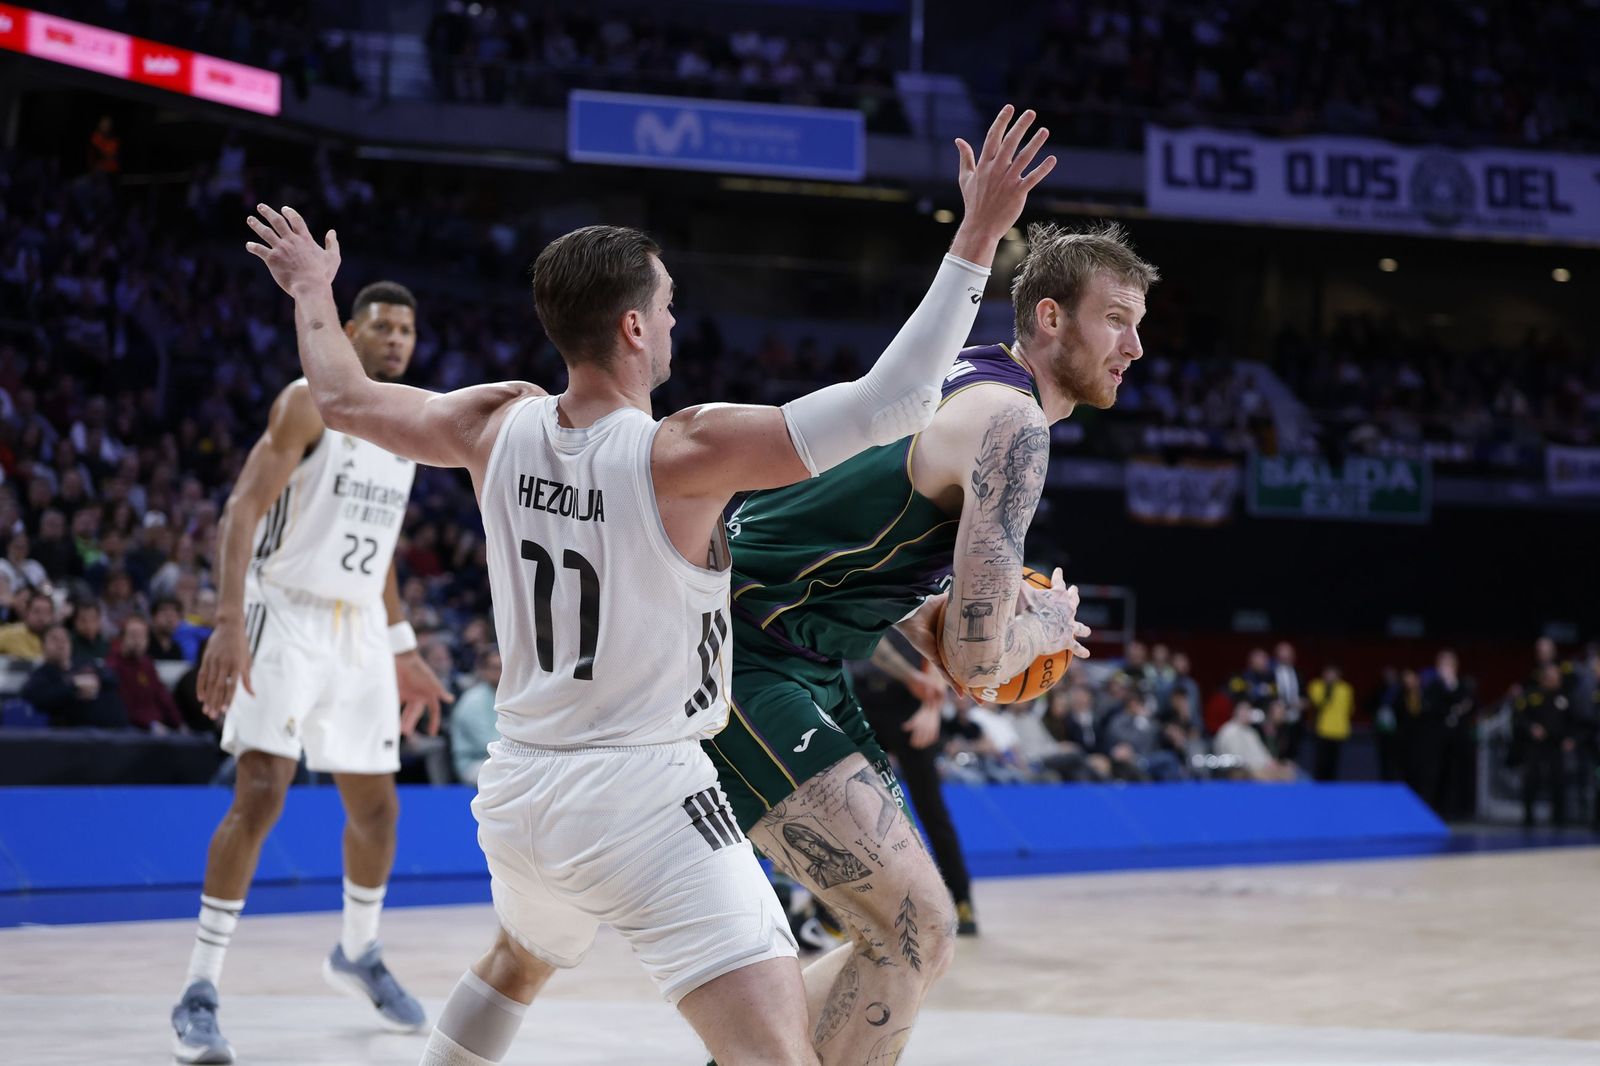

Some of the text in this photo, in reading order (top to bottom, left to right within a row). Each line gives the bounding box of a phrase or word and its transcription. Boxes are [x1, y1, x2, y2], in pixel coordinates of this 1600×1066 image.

[1164, 141, 1577, 216] LOS OJOS DEL
[1261, 456, 1418, 492] SALIDA
[341, 533, 378, 575] 22
[520, 539, 600, 681] 11
[855, 838, 884, 868] VIDI
